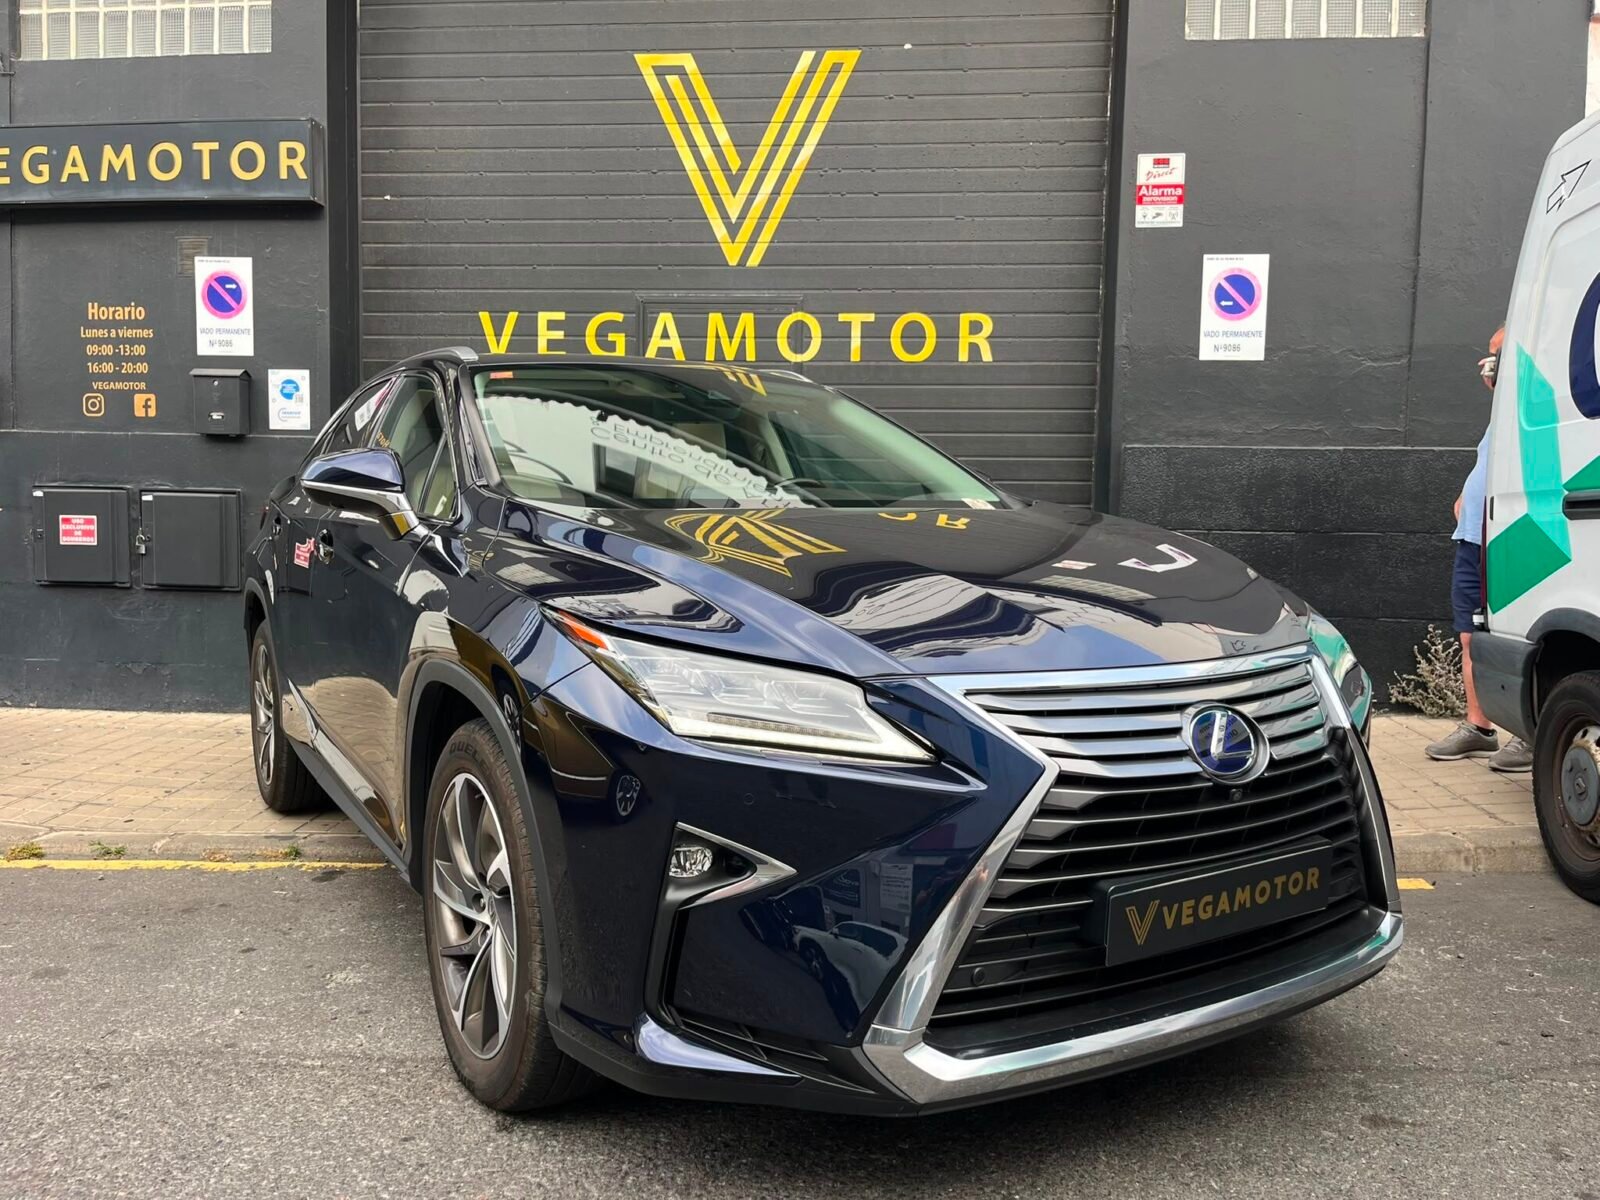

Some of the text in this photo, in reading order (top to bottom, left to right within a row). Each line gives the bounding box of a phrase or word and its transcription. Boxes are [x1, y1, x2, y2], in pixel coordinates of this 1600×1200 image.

[1138, 185, 1183, 196] Alarma
[87, 302, 146, 320] Horario
[80, 326, 154, 338] Lunes a viernes
[199, 327, 251, 336] VADO PERMANENTE
[478, 311, 994, 362] VEGAMOTOR
[1203, 330, 1264, 338] VADO PERMANENTE
[86, 344, 113, 356] 09:00
[87, 362, 114, 374] 16:00
[121, 362, 149, 374] 20:00
[92, 381, 146, 391] VEGAMOTOR
[1162, 867, 1320, 930] VEGAMOTOR
